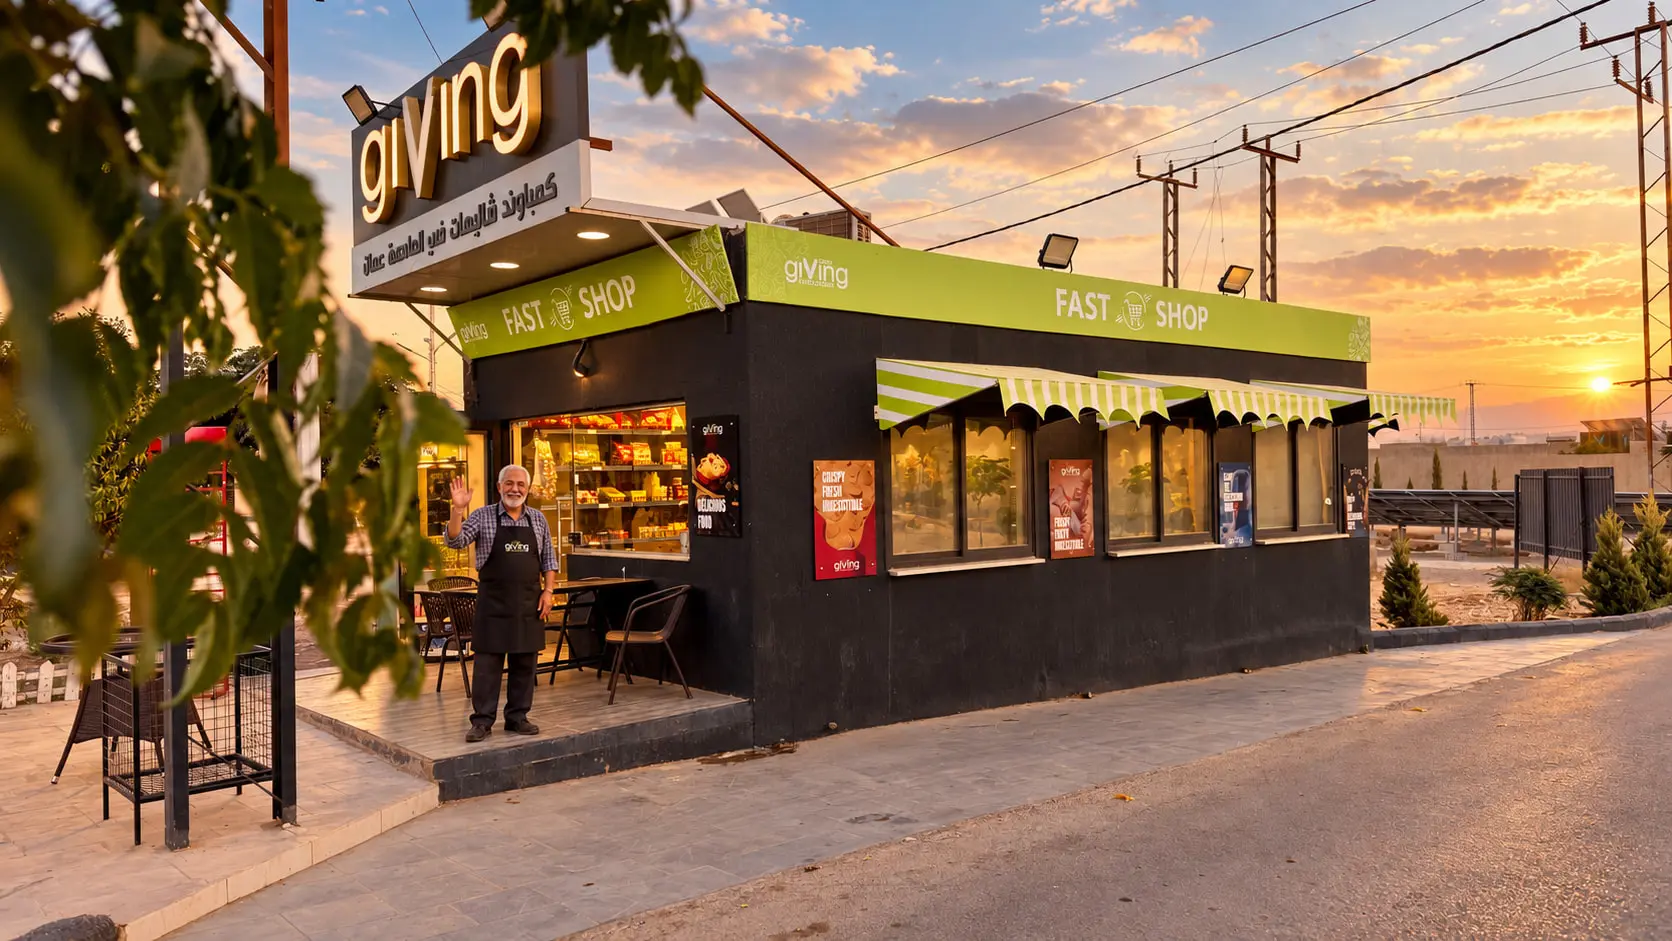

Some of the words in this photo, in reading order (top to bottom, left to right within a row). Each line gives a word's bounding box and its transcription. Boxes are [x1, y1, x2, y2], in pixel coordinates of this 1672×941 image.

[502, 299, 545, 336] FAST
[578, 275, 636, 319] SHOP
[1055, 287, 1110, 321] FAST
[1156, 300, 1209, 331] SHOP
